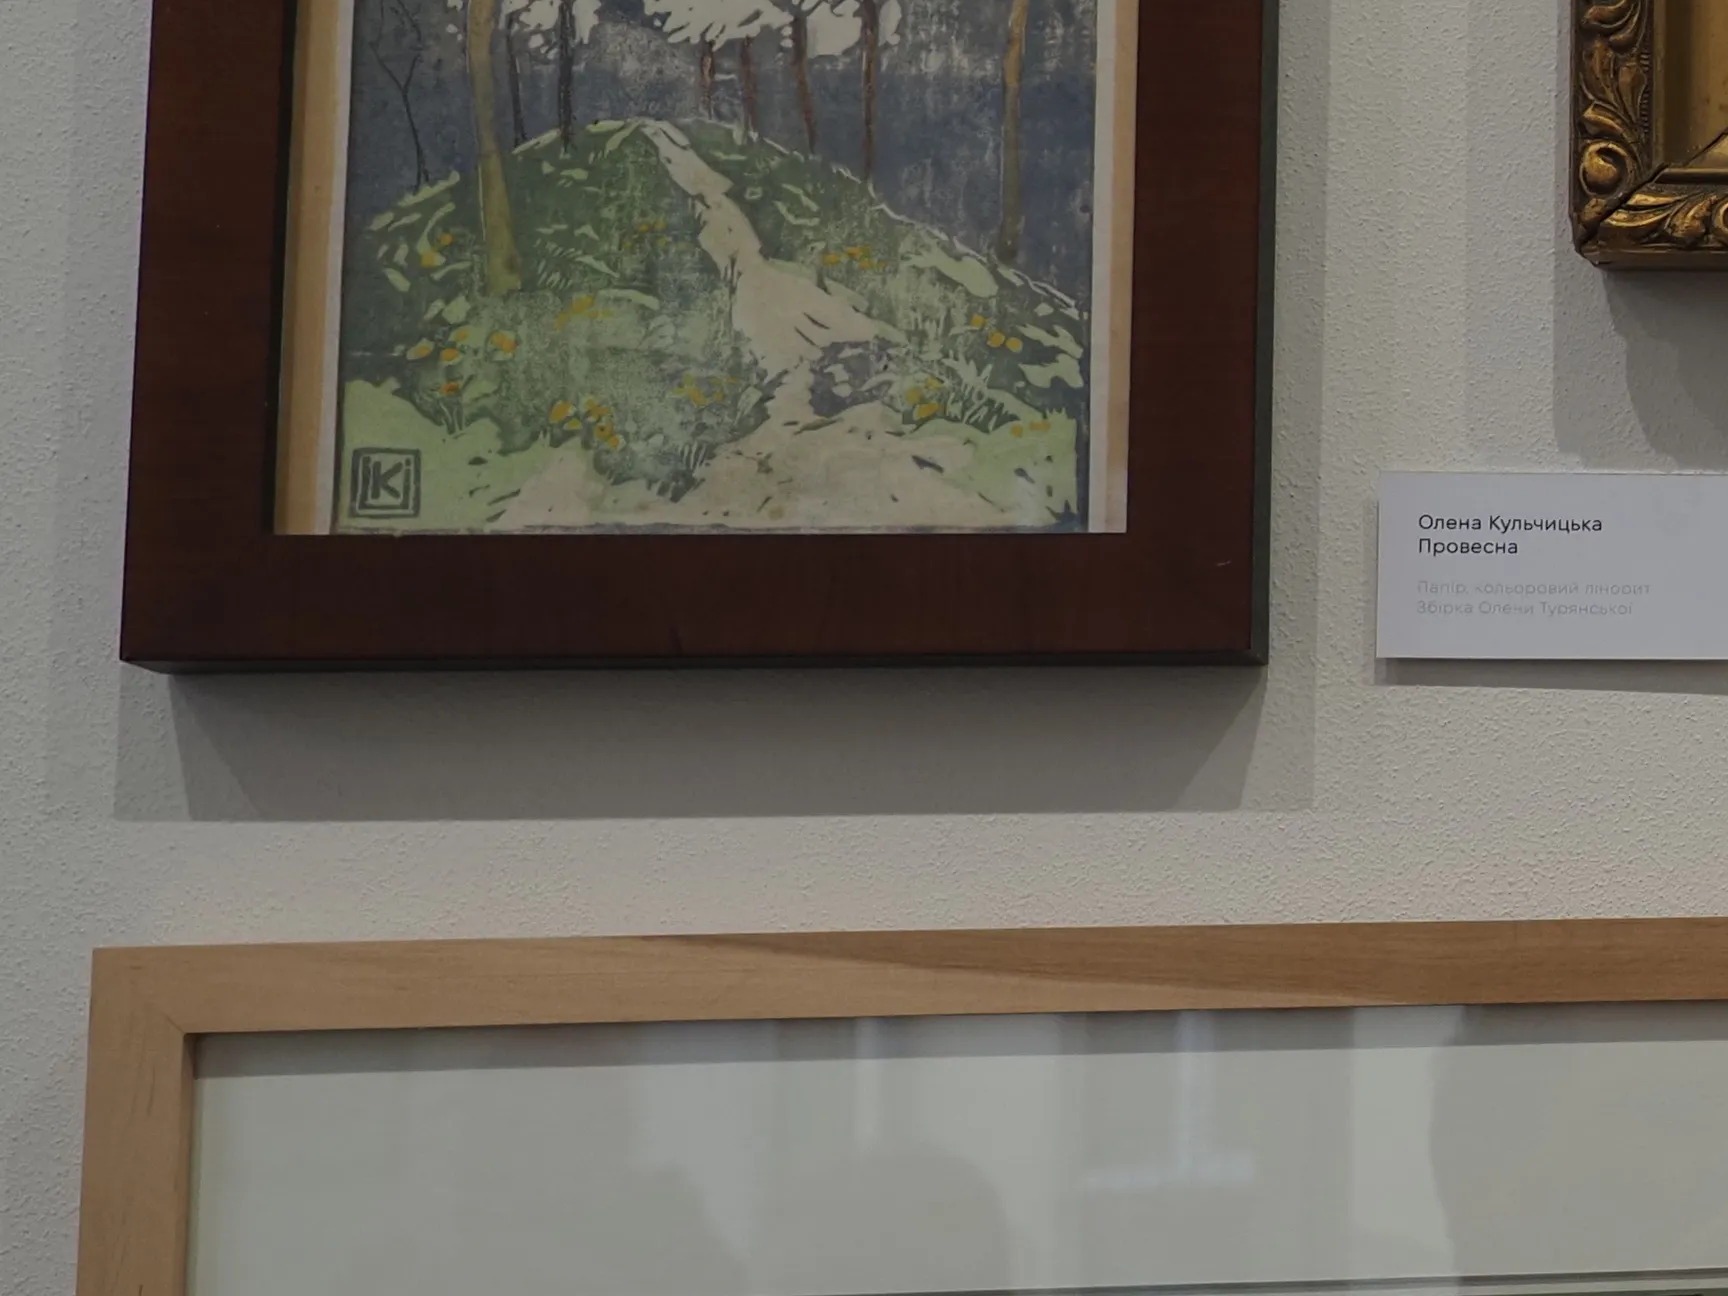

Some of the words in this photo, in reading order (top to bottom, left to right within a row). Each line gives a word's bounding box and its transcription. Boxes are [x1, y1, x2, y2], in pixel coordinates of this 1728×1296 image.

[1418, 514, 1483, 531] Олена
[1488, 514, 1603, 534] Кульчицька
[1418, 538, 1518, 557] Провесна
[1416, 601, 1473, 618] Збірка
